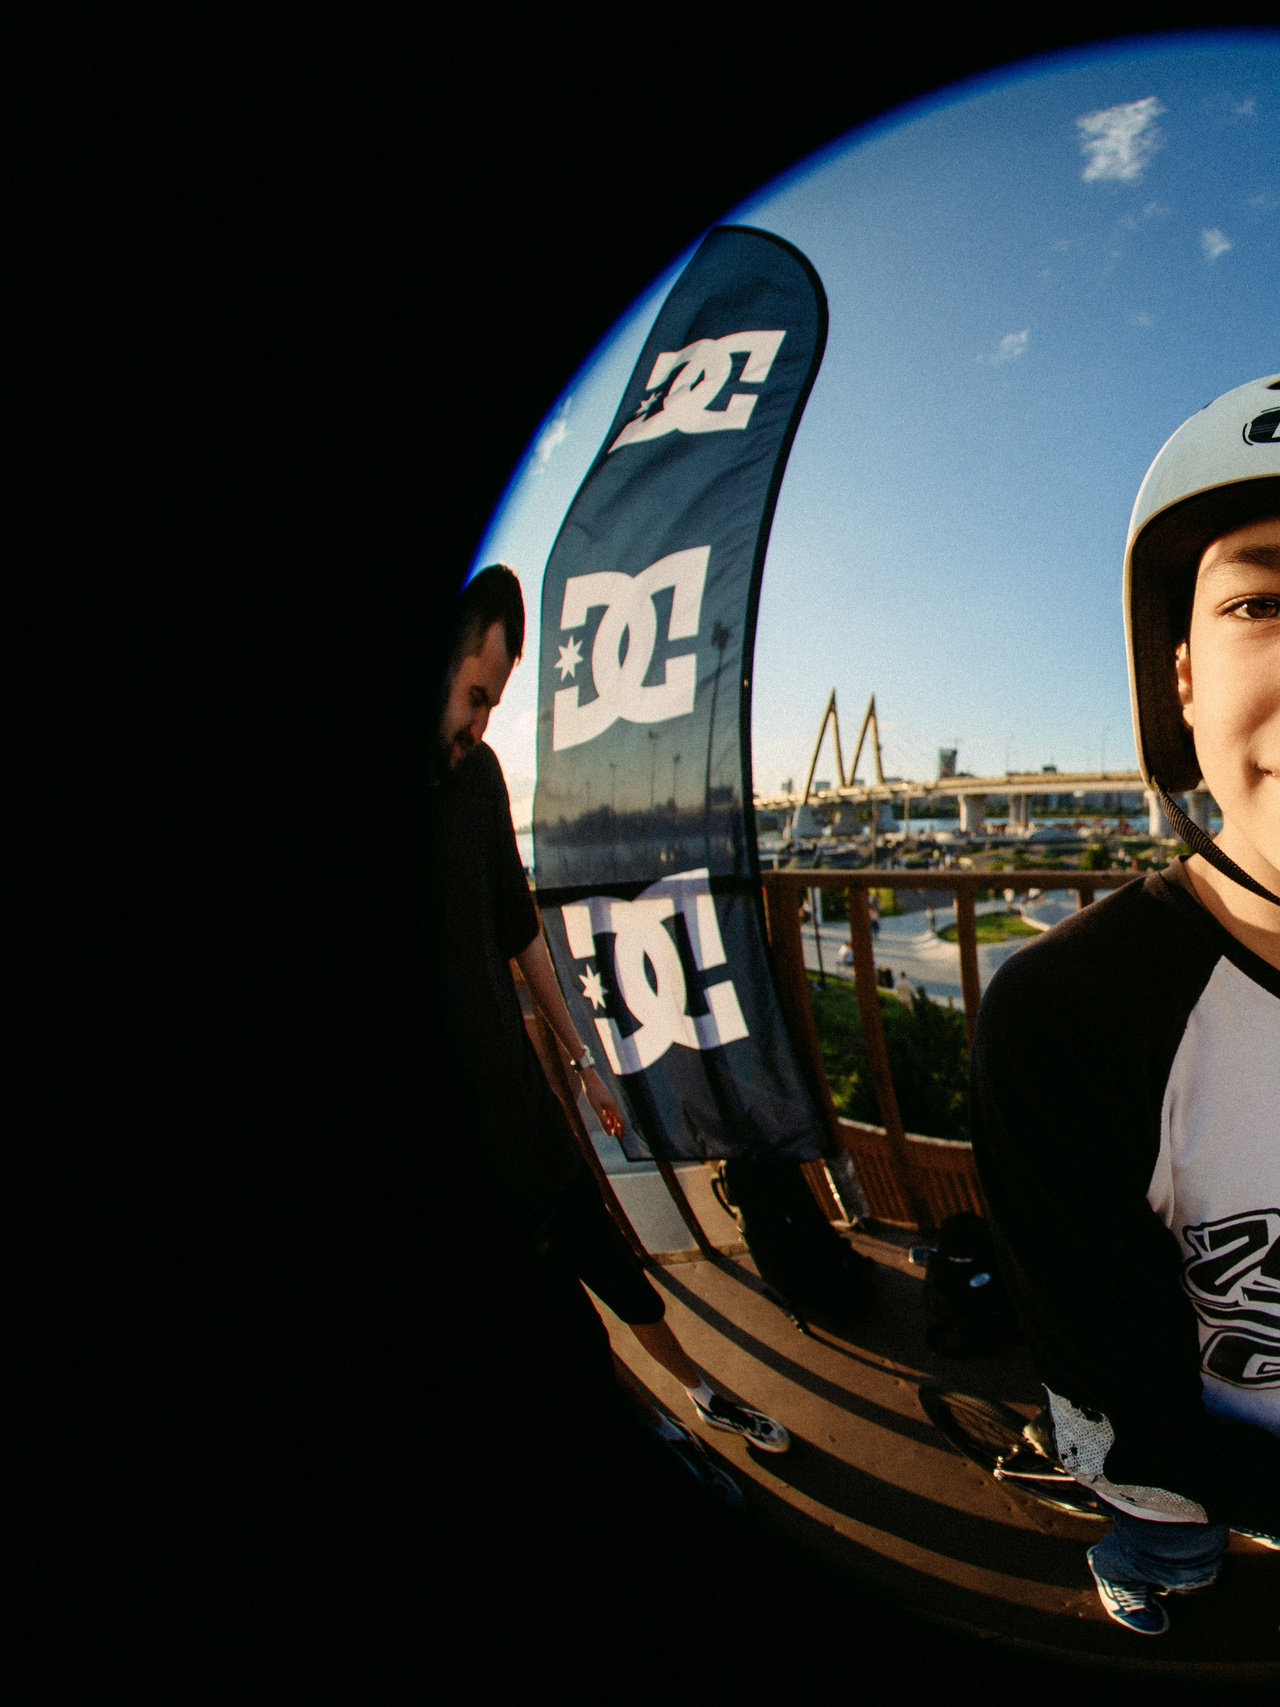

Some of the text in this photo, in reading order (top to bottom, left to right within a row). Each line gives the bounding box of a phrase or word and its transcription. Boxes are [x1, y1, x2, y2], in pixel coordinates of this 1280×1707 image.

[608, 329, 787, 454] DC
[552, 544, 711, 752] DC
[560, 867, 750, 1076] DC
